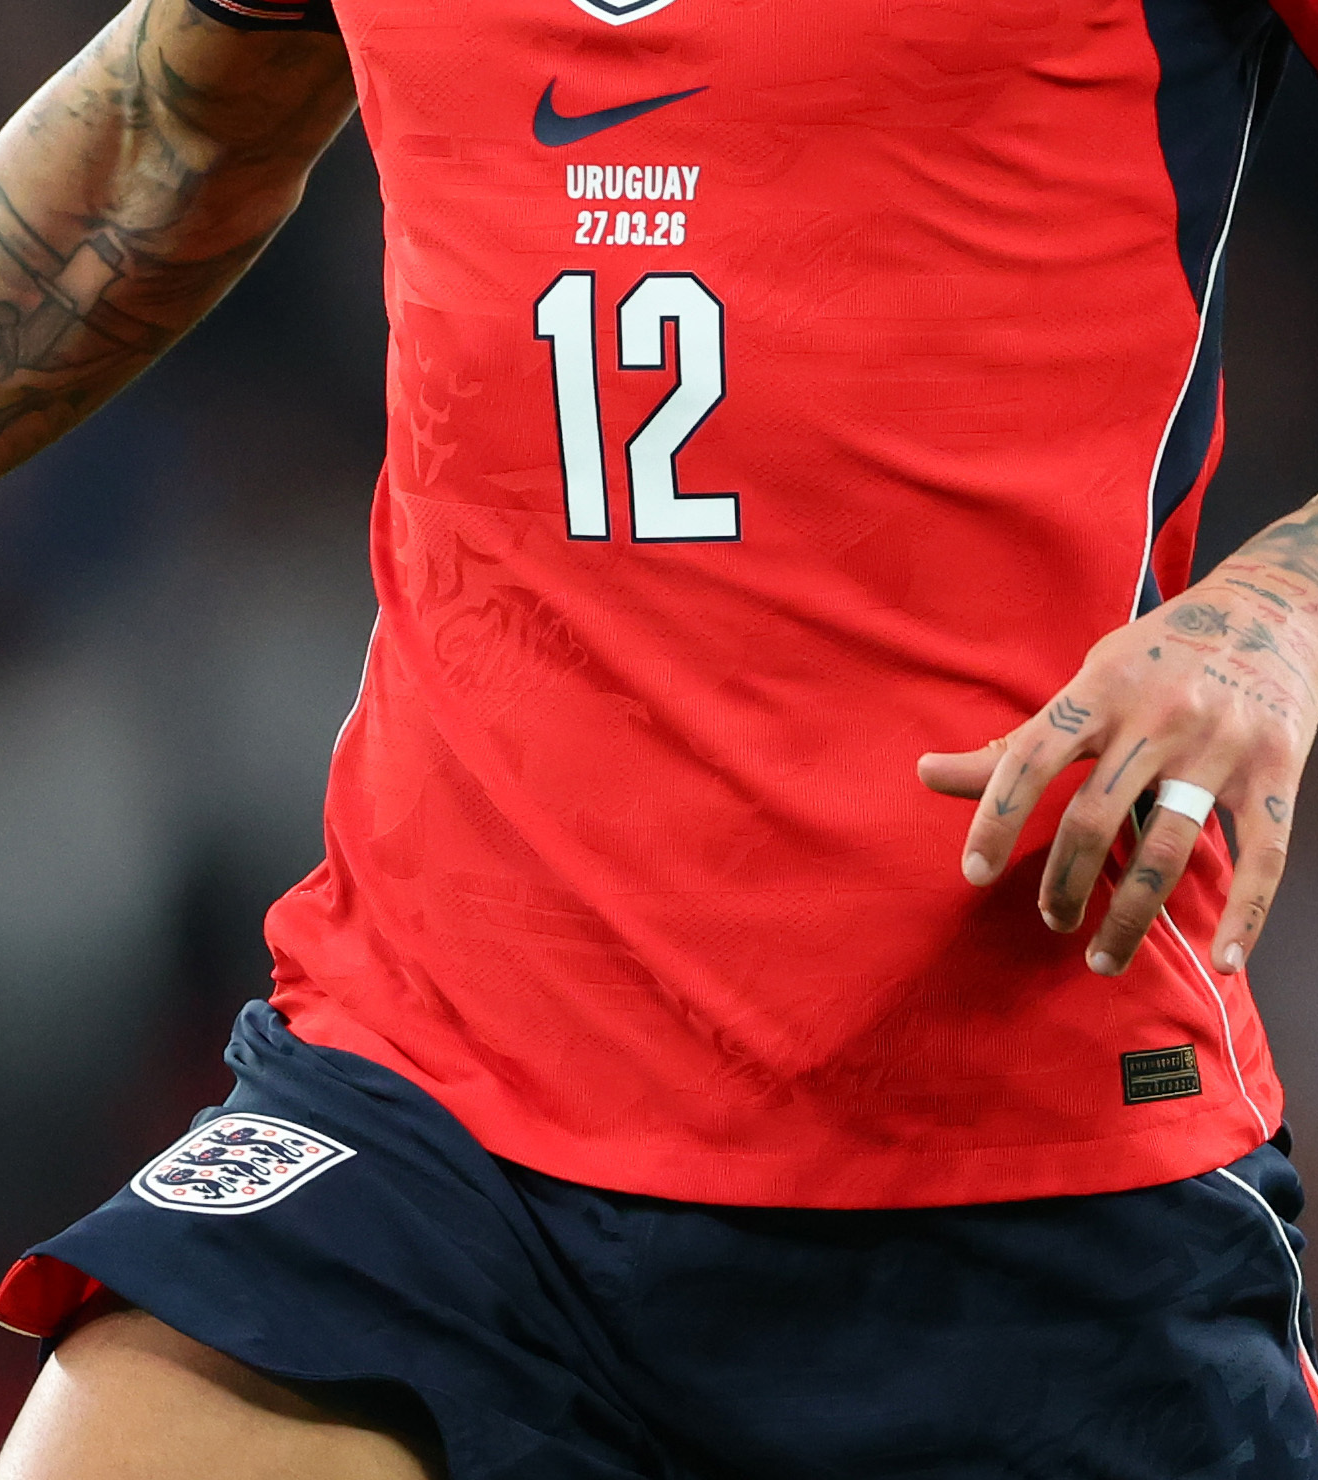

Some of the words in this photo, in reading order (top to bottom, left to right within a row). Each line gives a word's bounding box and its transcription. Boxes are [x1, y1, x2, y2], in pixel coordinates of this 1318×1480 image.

[566, 165, 700, 201] URUGUAY
[575, 211, 686, 246] 27.03.26
[534, 270, 741, 543] 12
